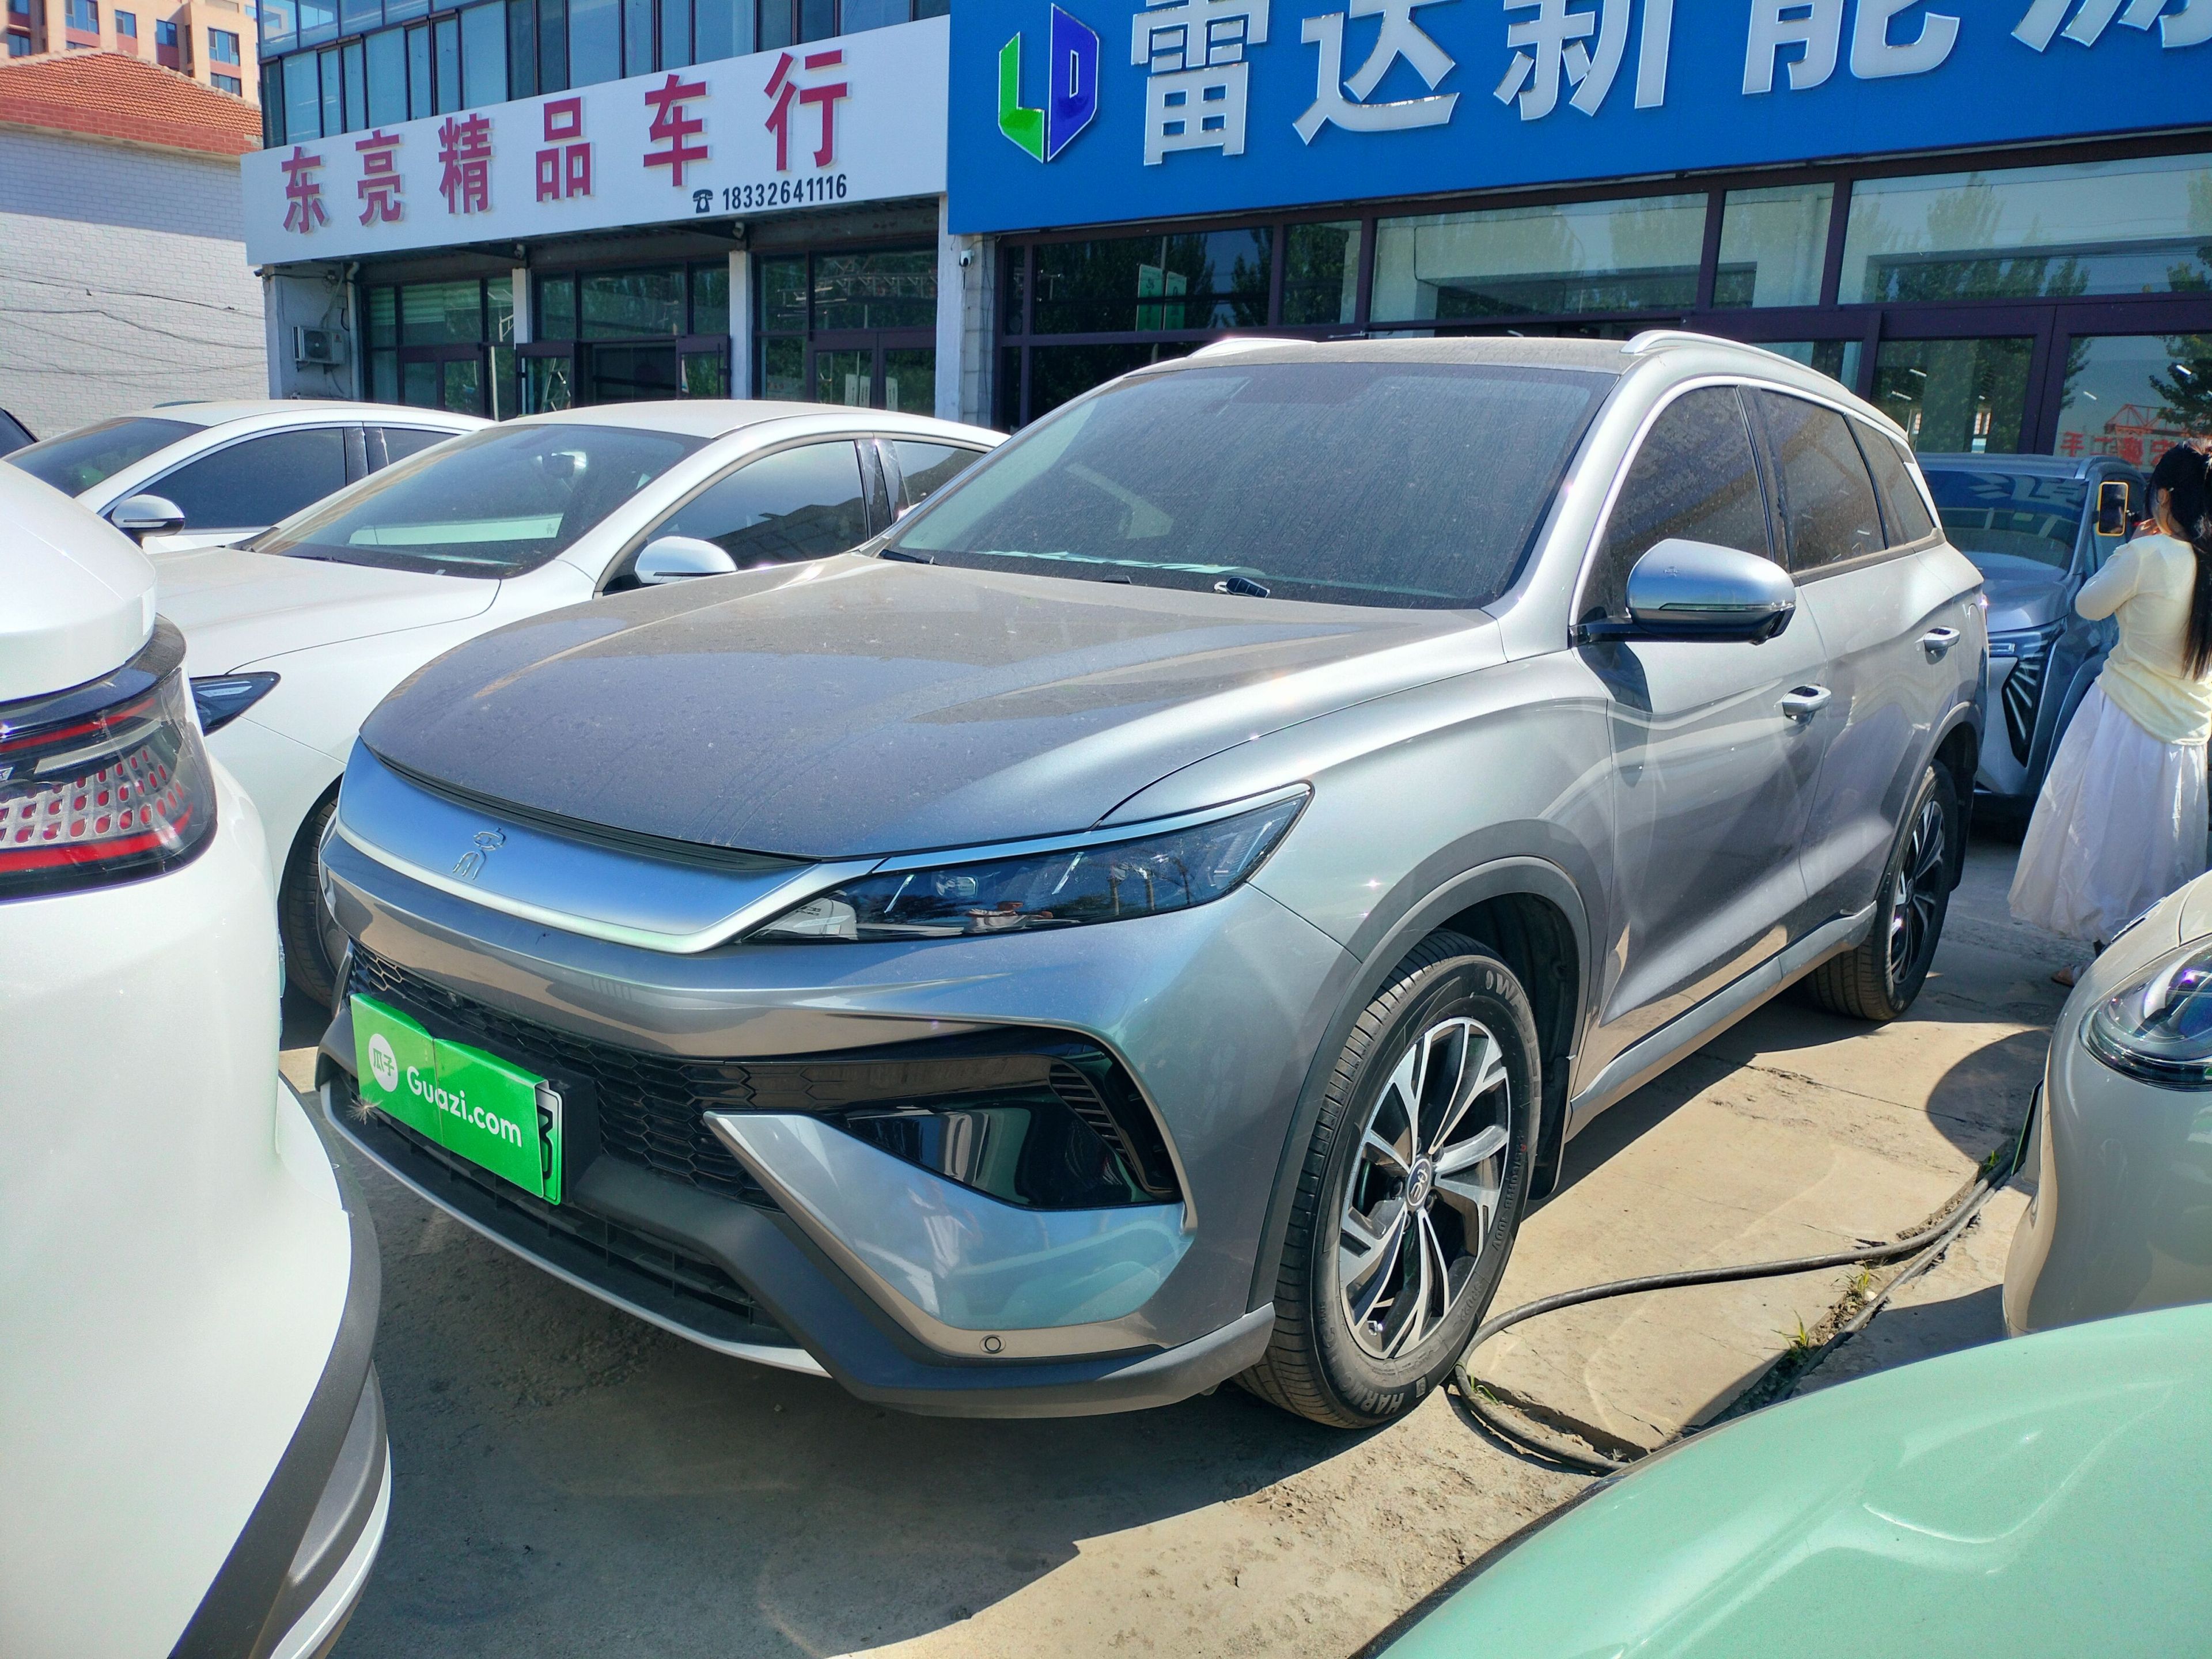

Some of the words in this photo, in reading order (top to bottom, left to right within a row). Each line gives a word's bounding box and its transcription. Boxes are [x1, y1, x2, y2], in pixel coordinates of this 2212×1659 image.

[1131, 0, 2212, 166] 雷达新能
[282, 49, 849, 234] 东亮精品车行
[721, 173, 848, 211] 18332641116
[373, 1048, 395, 1077] 瓜子
[407, 1066, 522, 1148] Guazi.com
